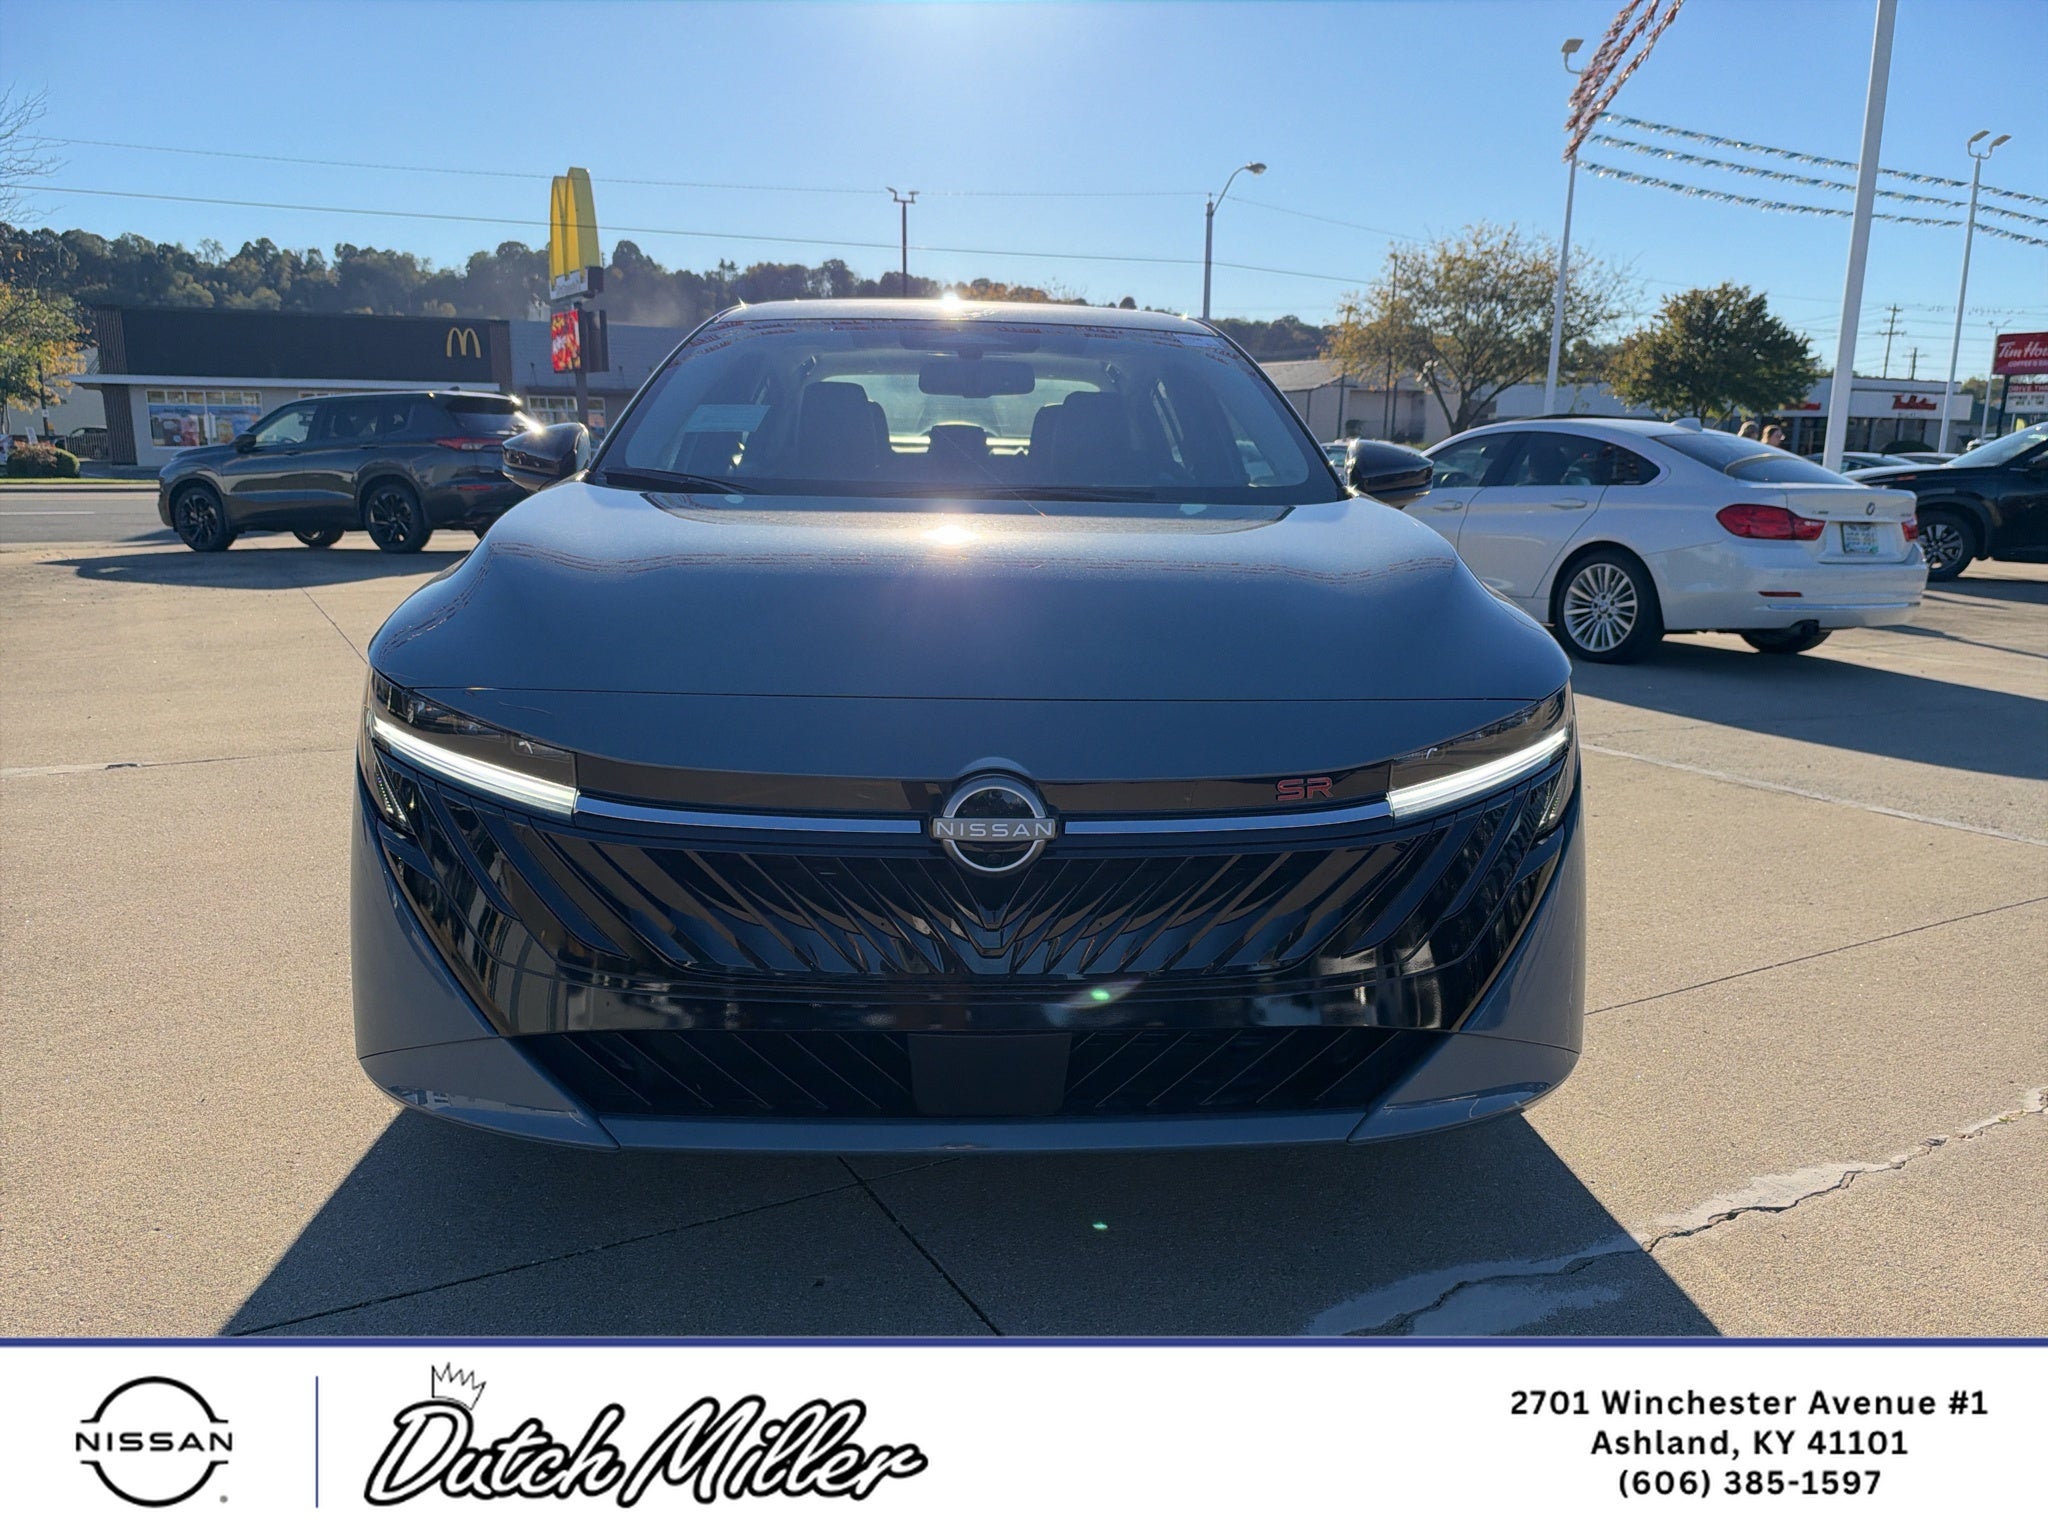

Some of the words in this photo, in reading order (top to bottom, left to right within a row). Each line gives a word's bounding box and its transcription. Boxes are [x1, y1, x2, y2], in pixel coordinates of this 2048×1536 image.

[1998, 341, 2022, 358] Tim
[1277, 776, 1334, 801] SR
[936, 821, 1052, 837] NISSAN
